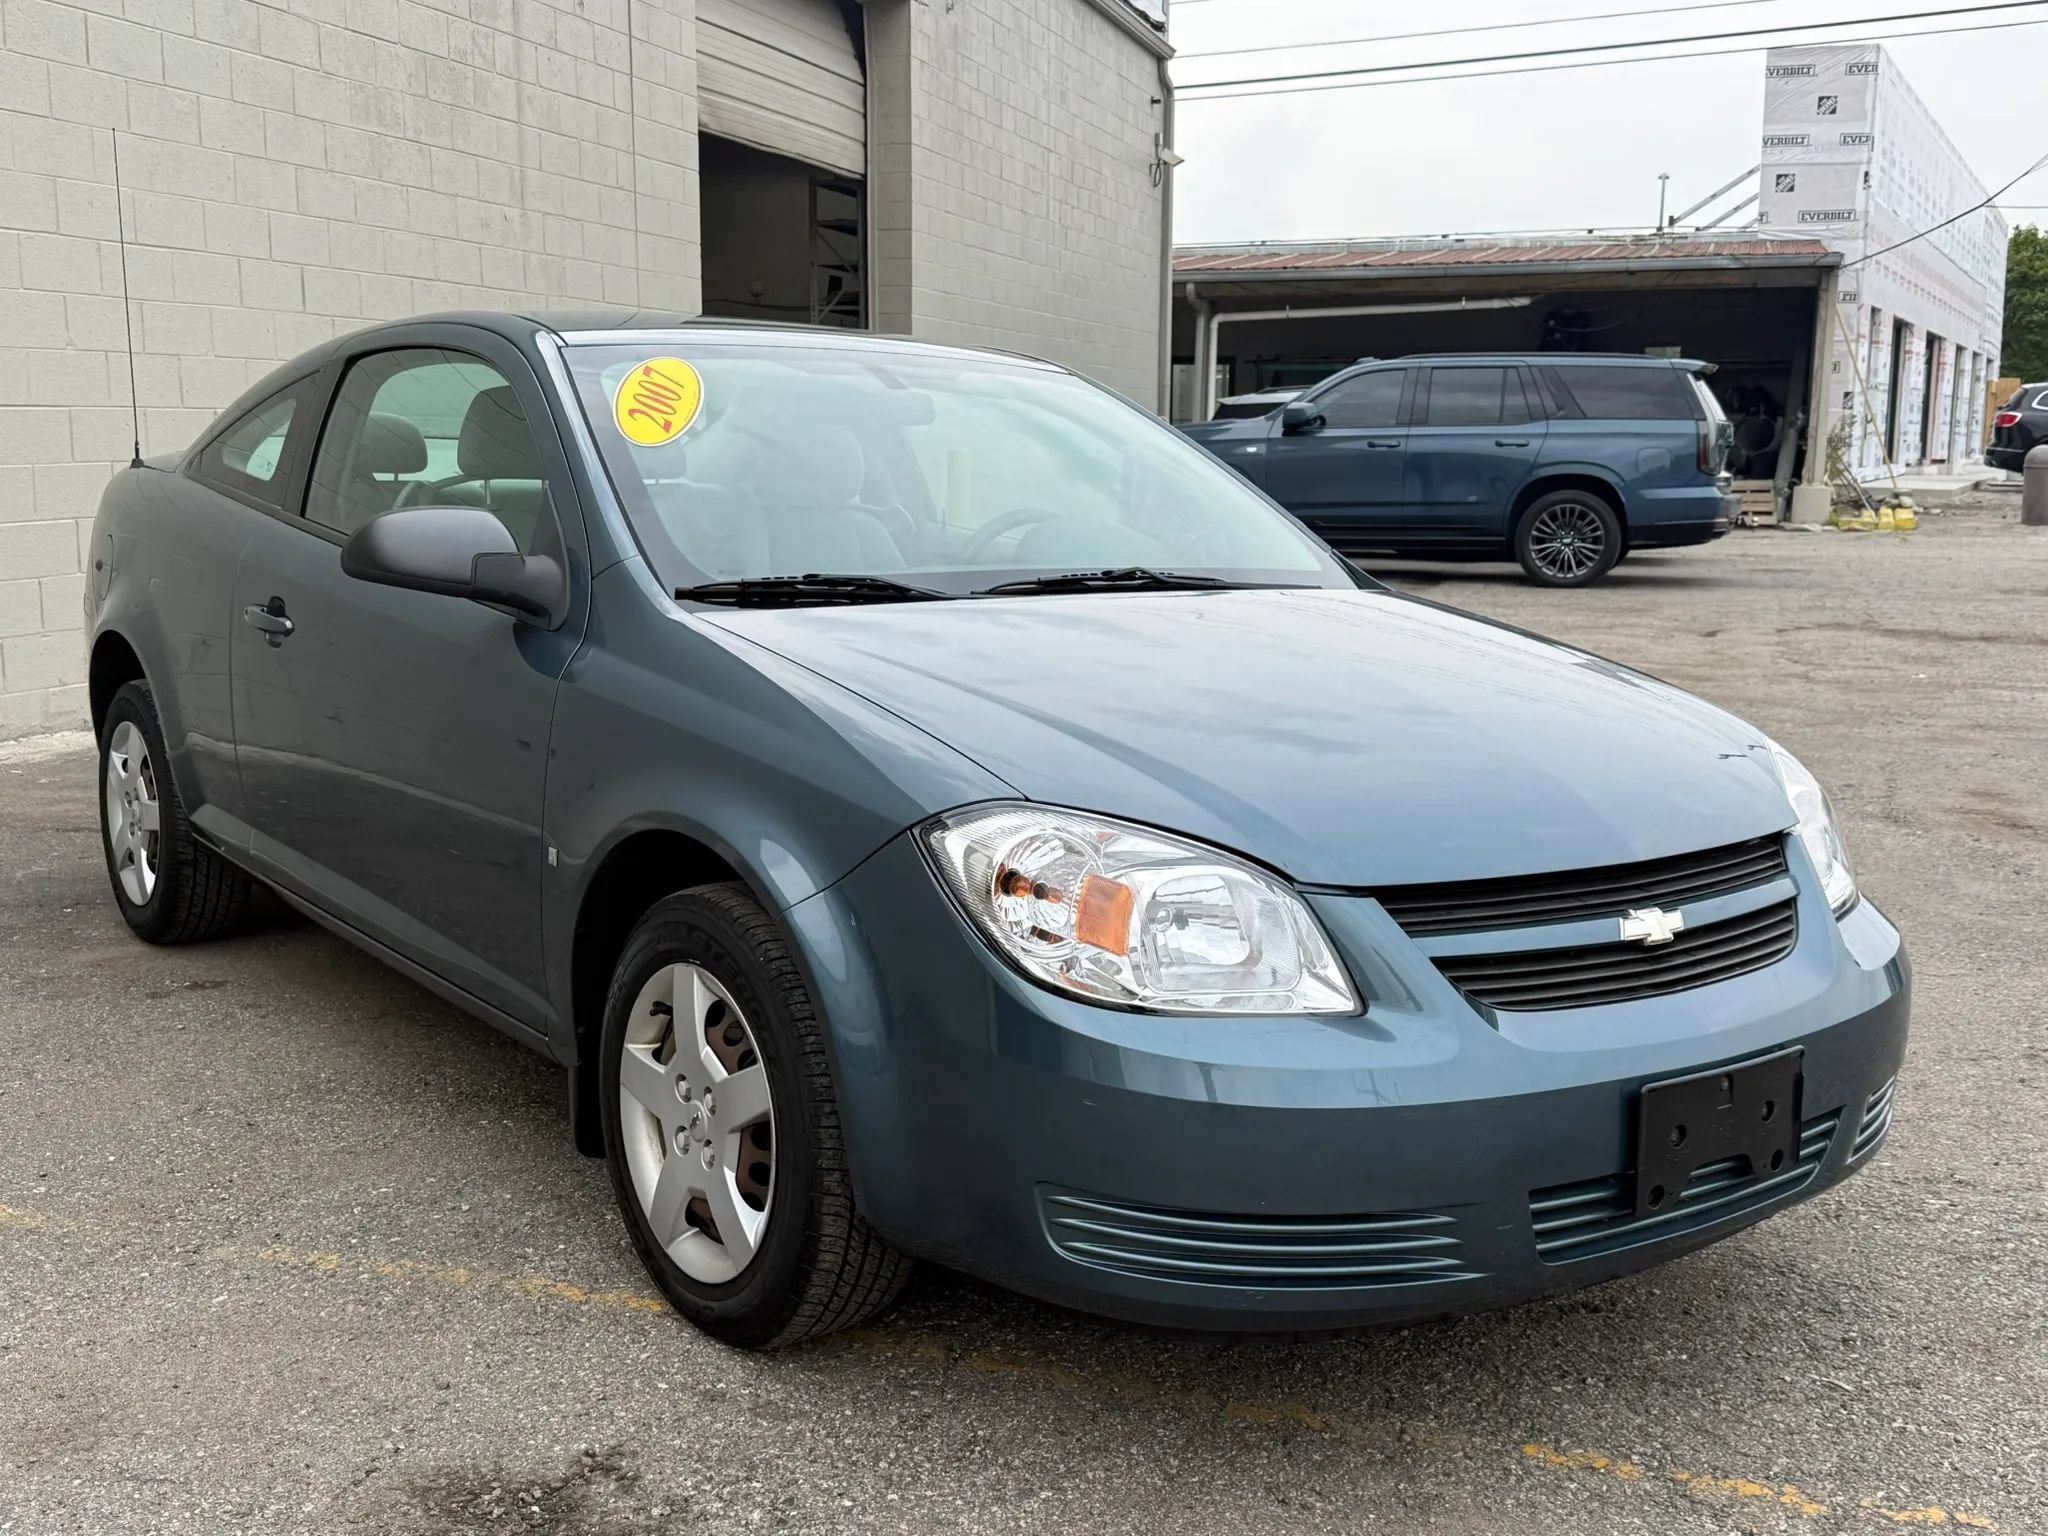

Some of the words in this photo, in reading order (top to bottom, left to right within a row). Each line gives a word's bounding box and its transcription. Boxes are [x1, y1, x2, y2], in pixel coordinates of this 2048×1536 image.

[1766, 67, 1813, 76] VERBILT
[1801, 211, 1853, 221] EVERBILT
[628, 366, 684, 433] 2007
